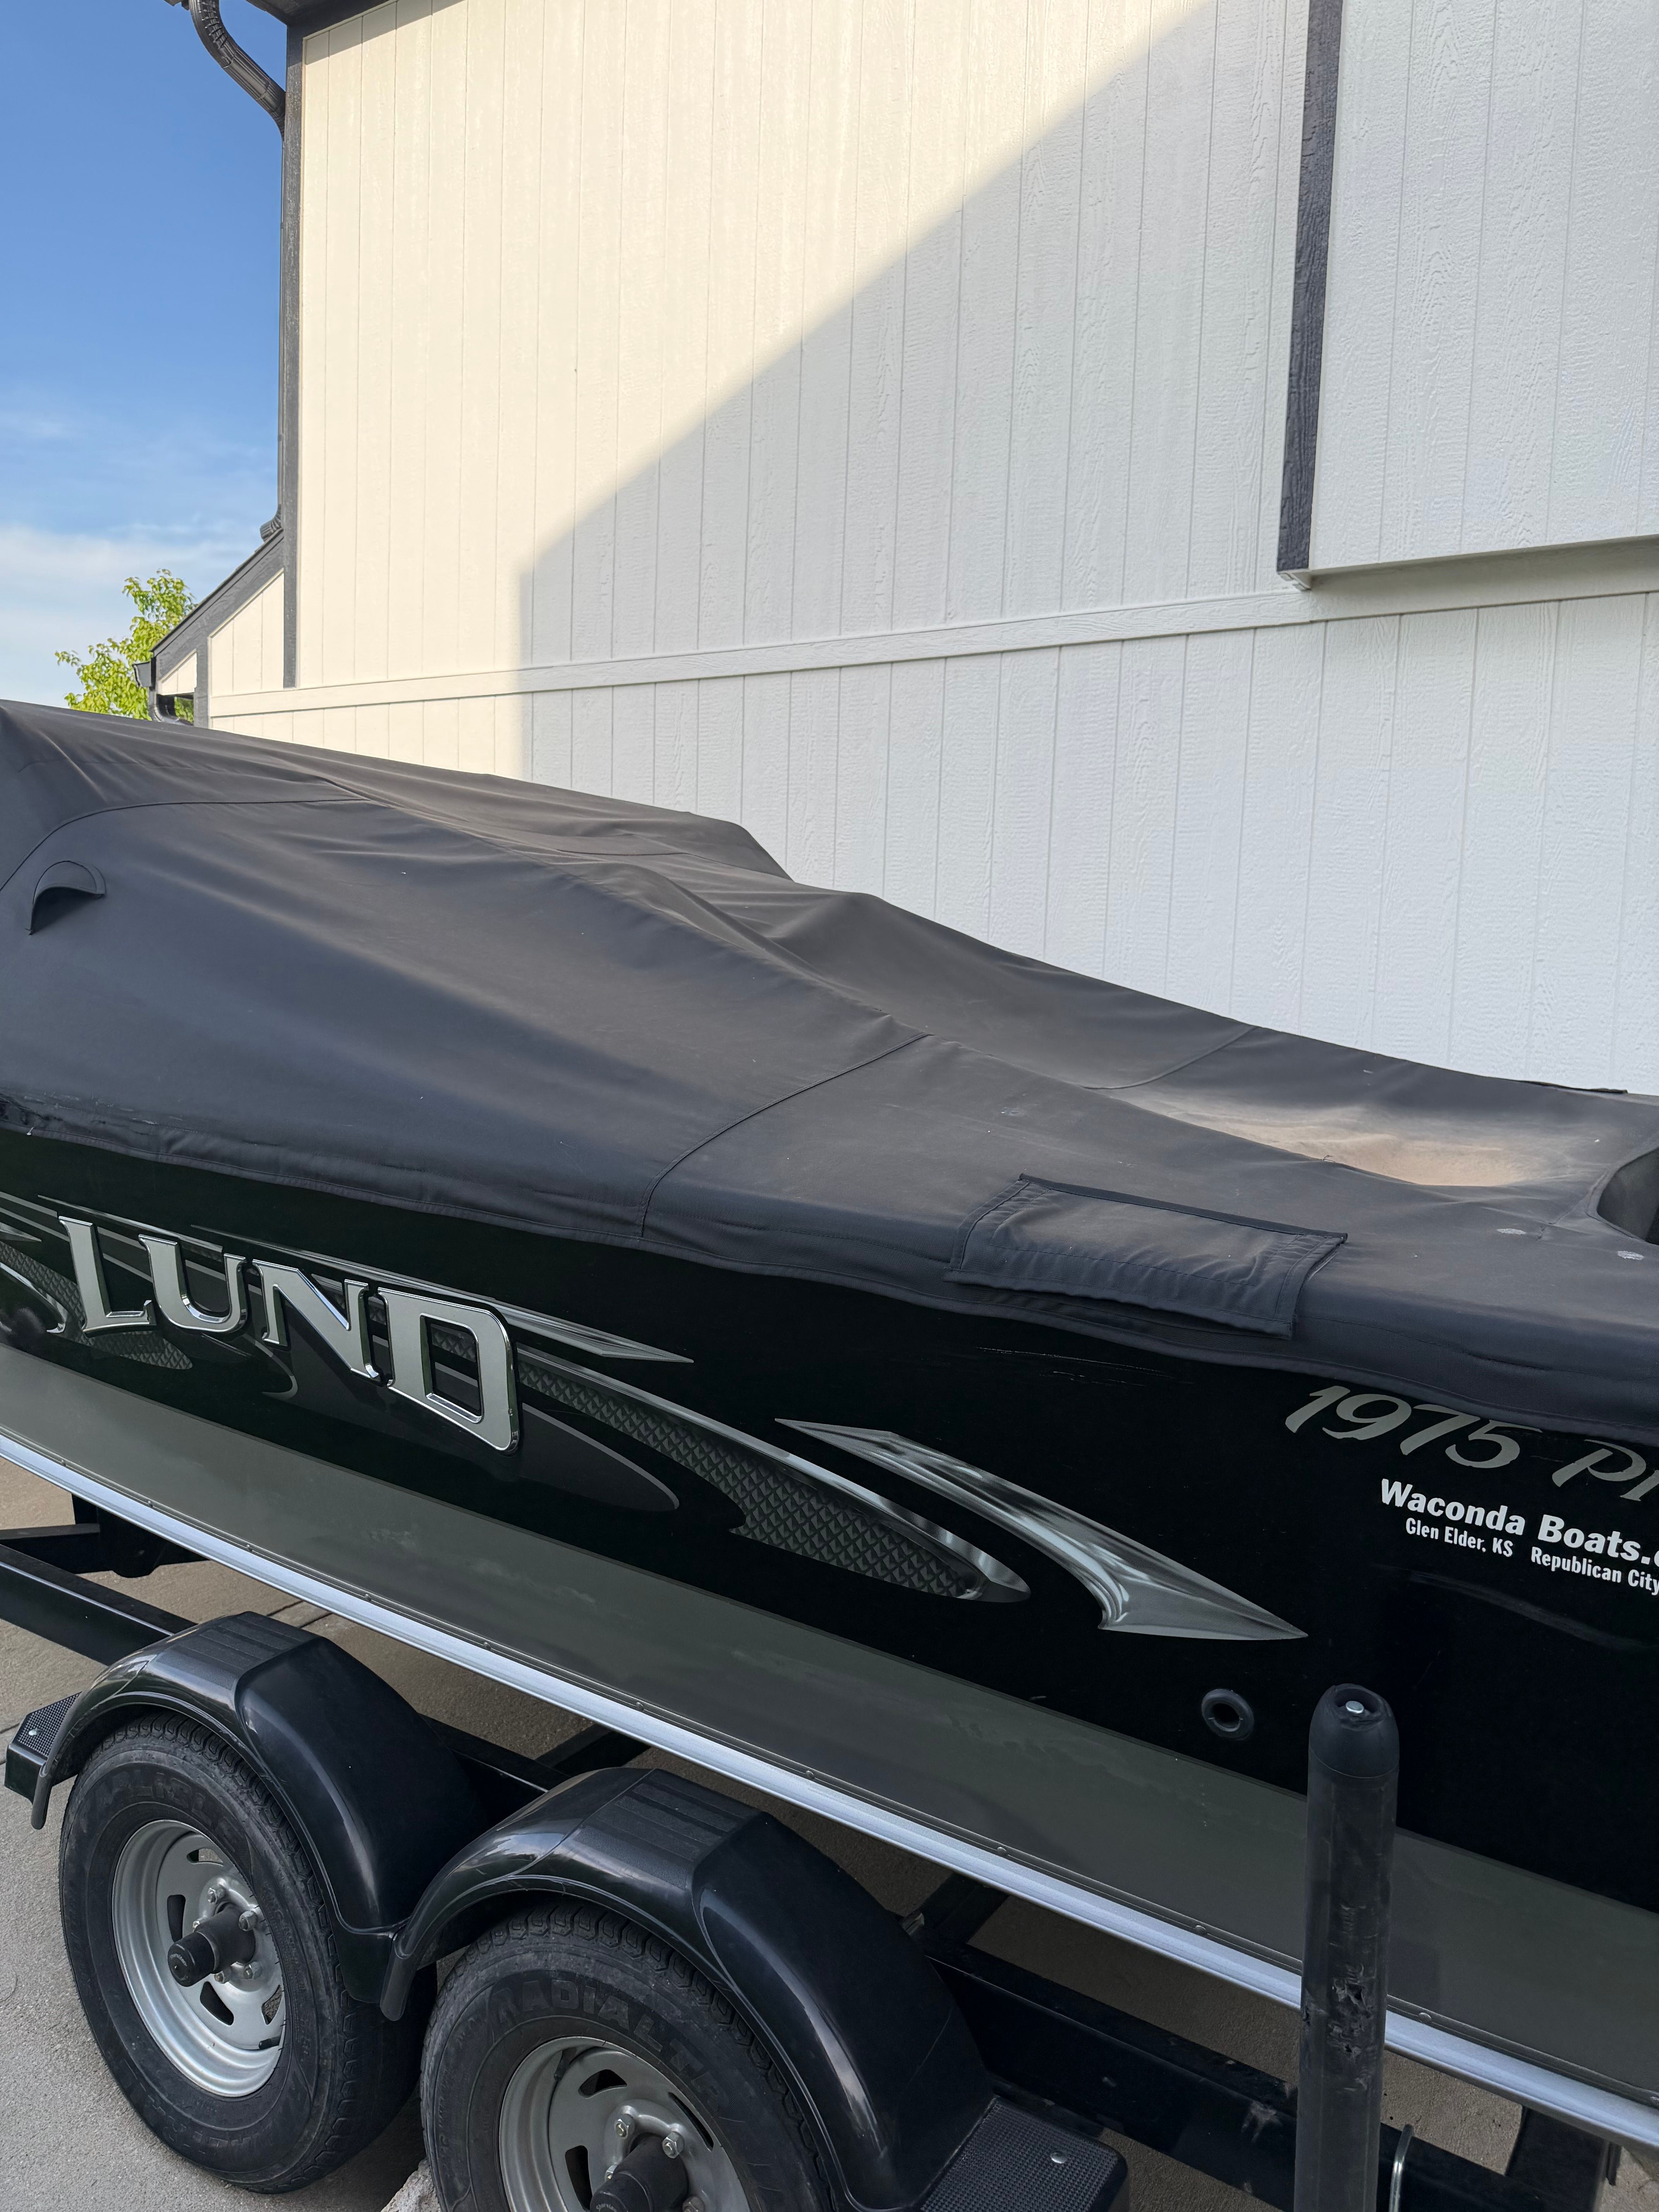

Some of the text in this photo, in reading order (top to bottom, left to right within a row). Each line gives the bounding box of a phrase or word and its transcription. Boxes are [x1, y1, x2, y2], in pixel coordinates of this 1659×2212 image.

[58, 1216, 520, 1454] LUND
[1285, 1386, 1543, 1469] 1975
[1381, 1478, 1659, 1567] Waconda Boats.
[1406, 1517, 1439, 1540] Glen
[1492, 1537, 1514, 1558] KS
[1531, 1546, 1622, 1584] Republican
[1628, 1569, 1659, 1595] City
